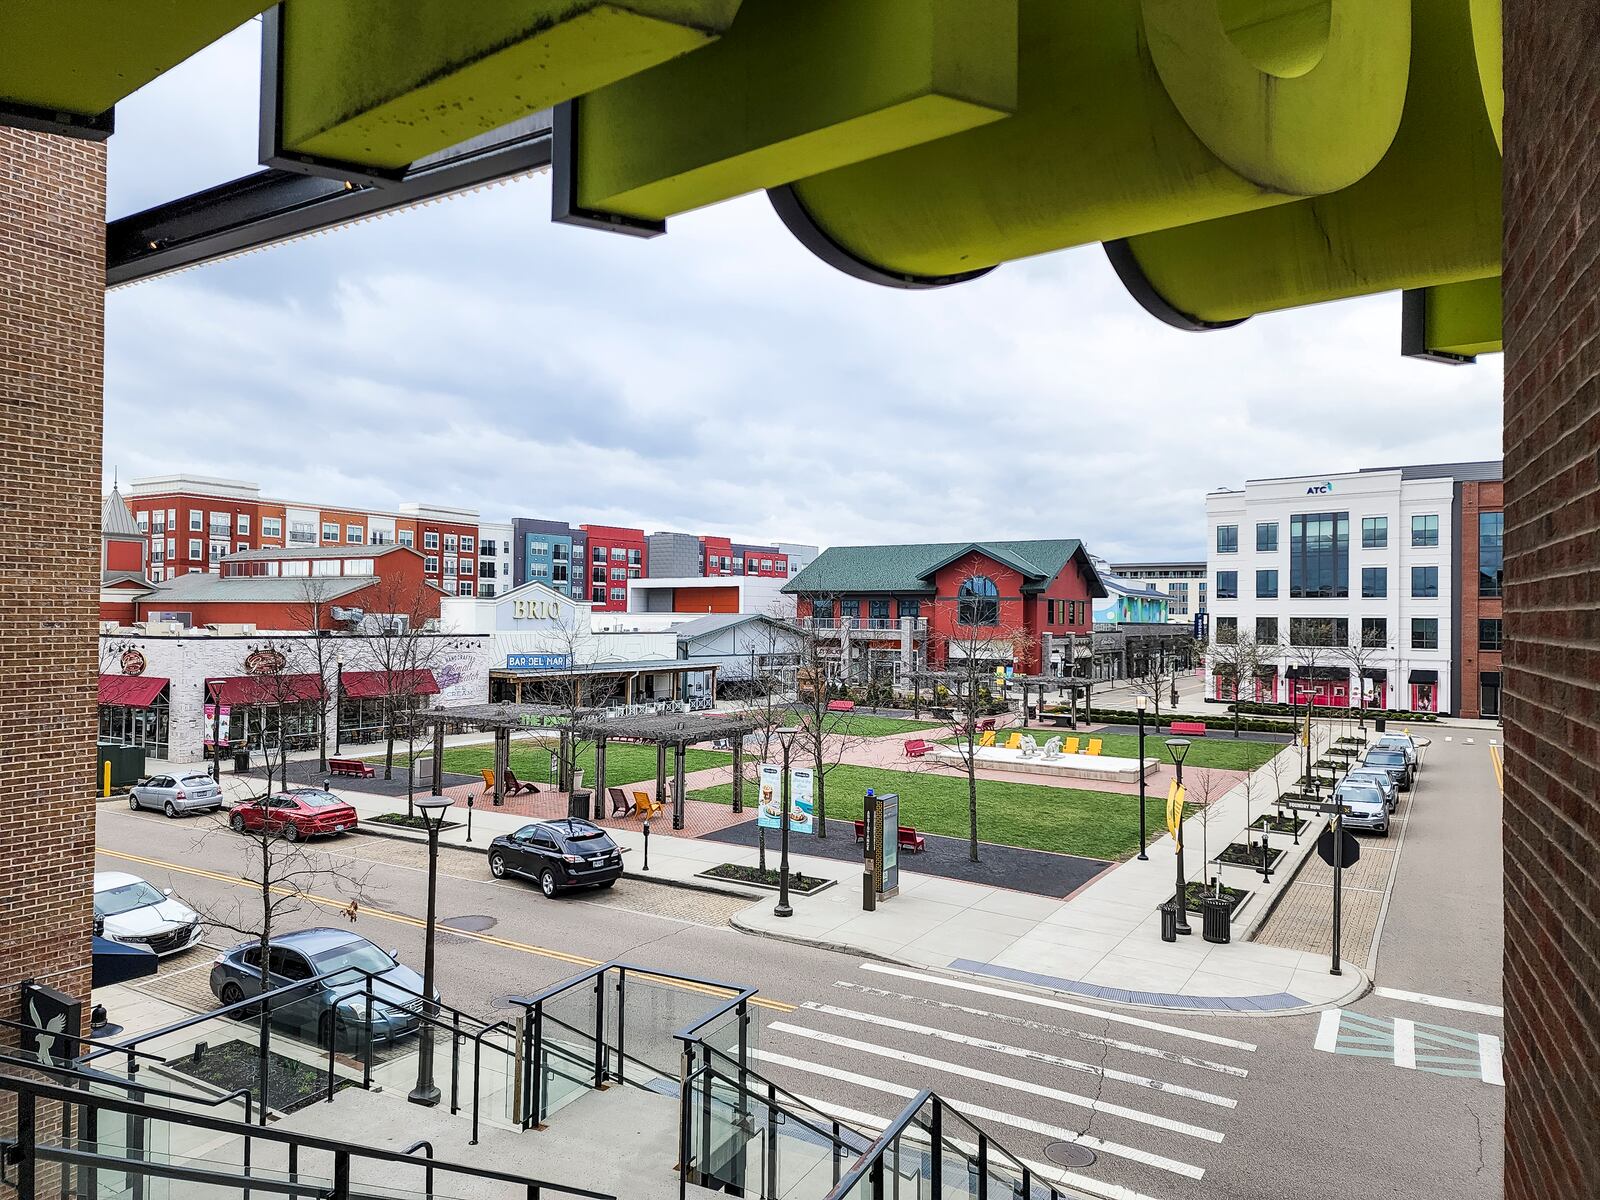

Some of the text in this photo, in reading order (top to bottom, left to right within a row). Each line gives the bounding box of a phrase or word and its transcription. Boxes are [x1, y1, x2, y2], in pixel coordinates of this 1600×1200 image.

[1307, 486, 1327, 494] ATC
[513, 600, 560, 620] BRIO
[509, 657, 563, 666] BAR DEL MAR
[519, 715, 540, 726] THE
